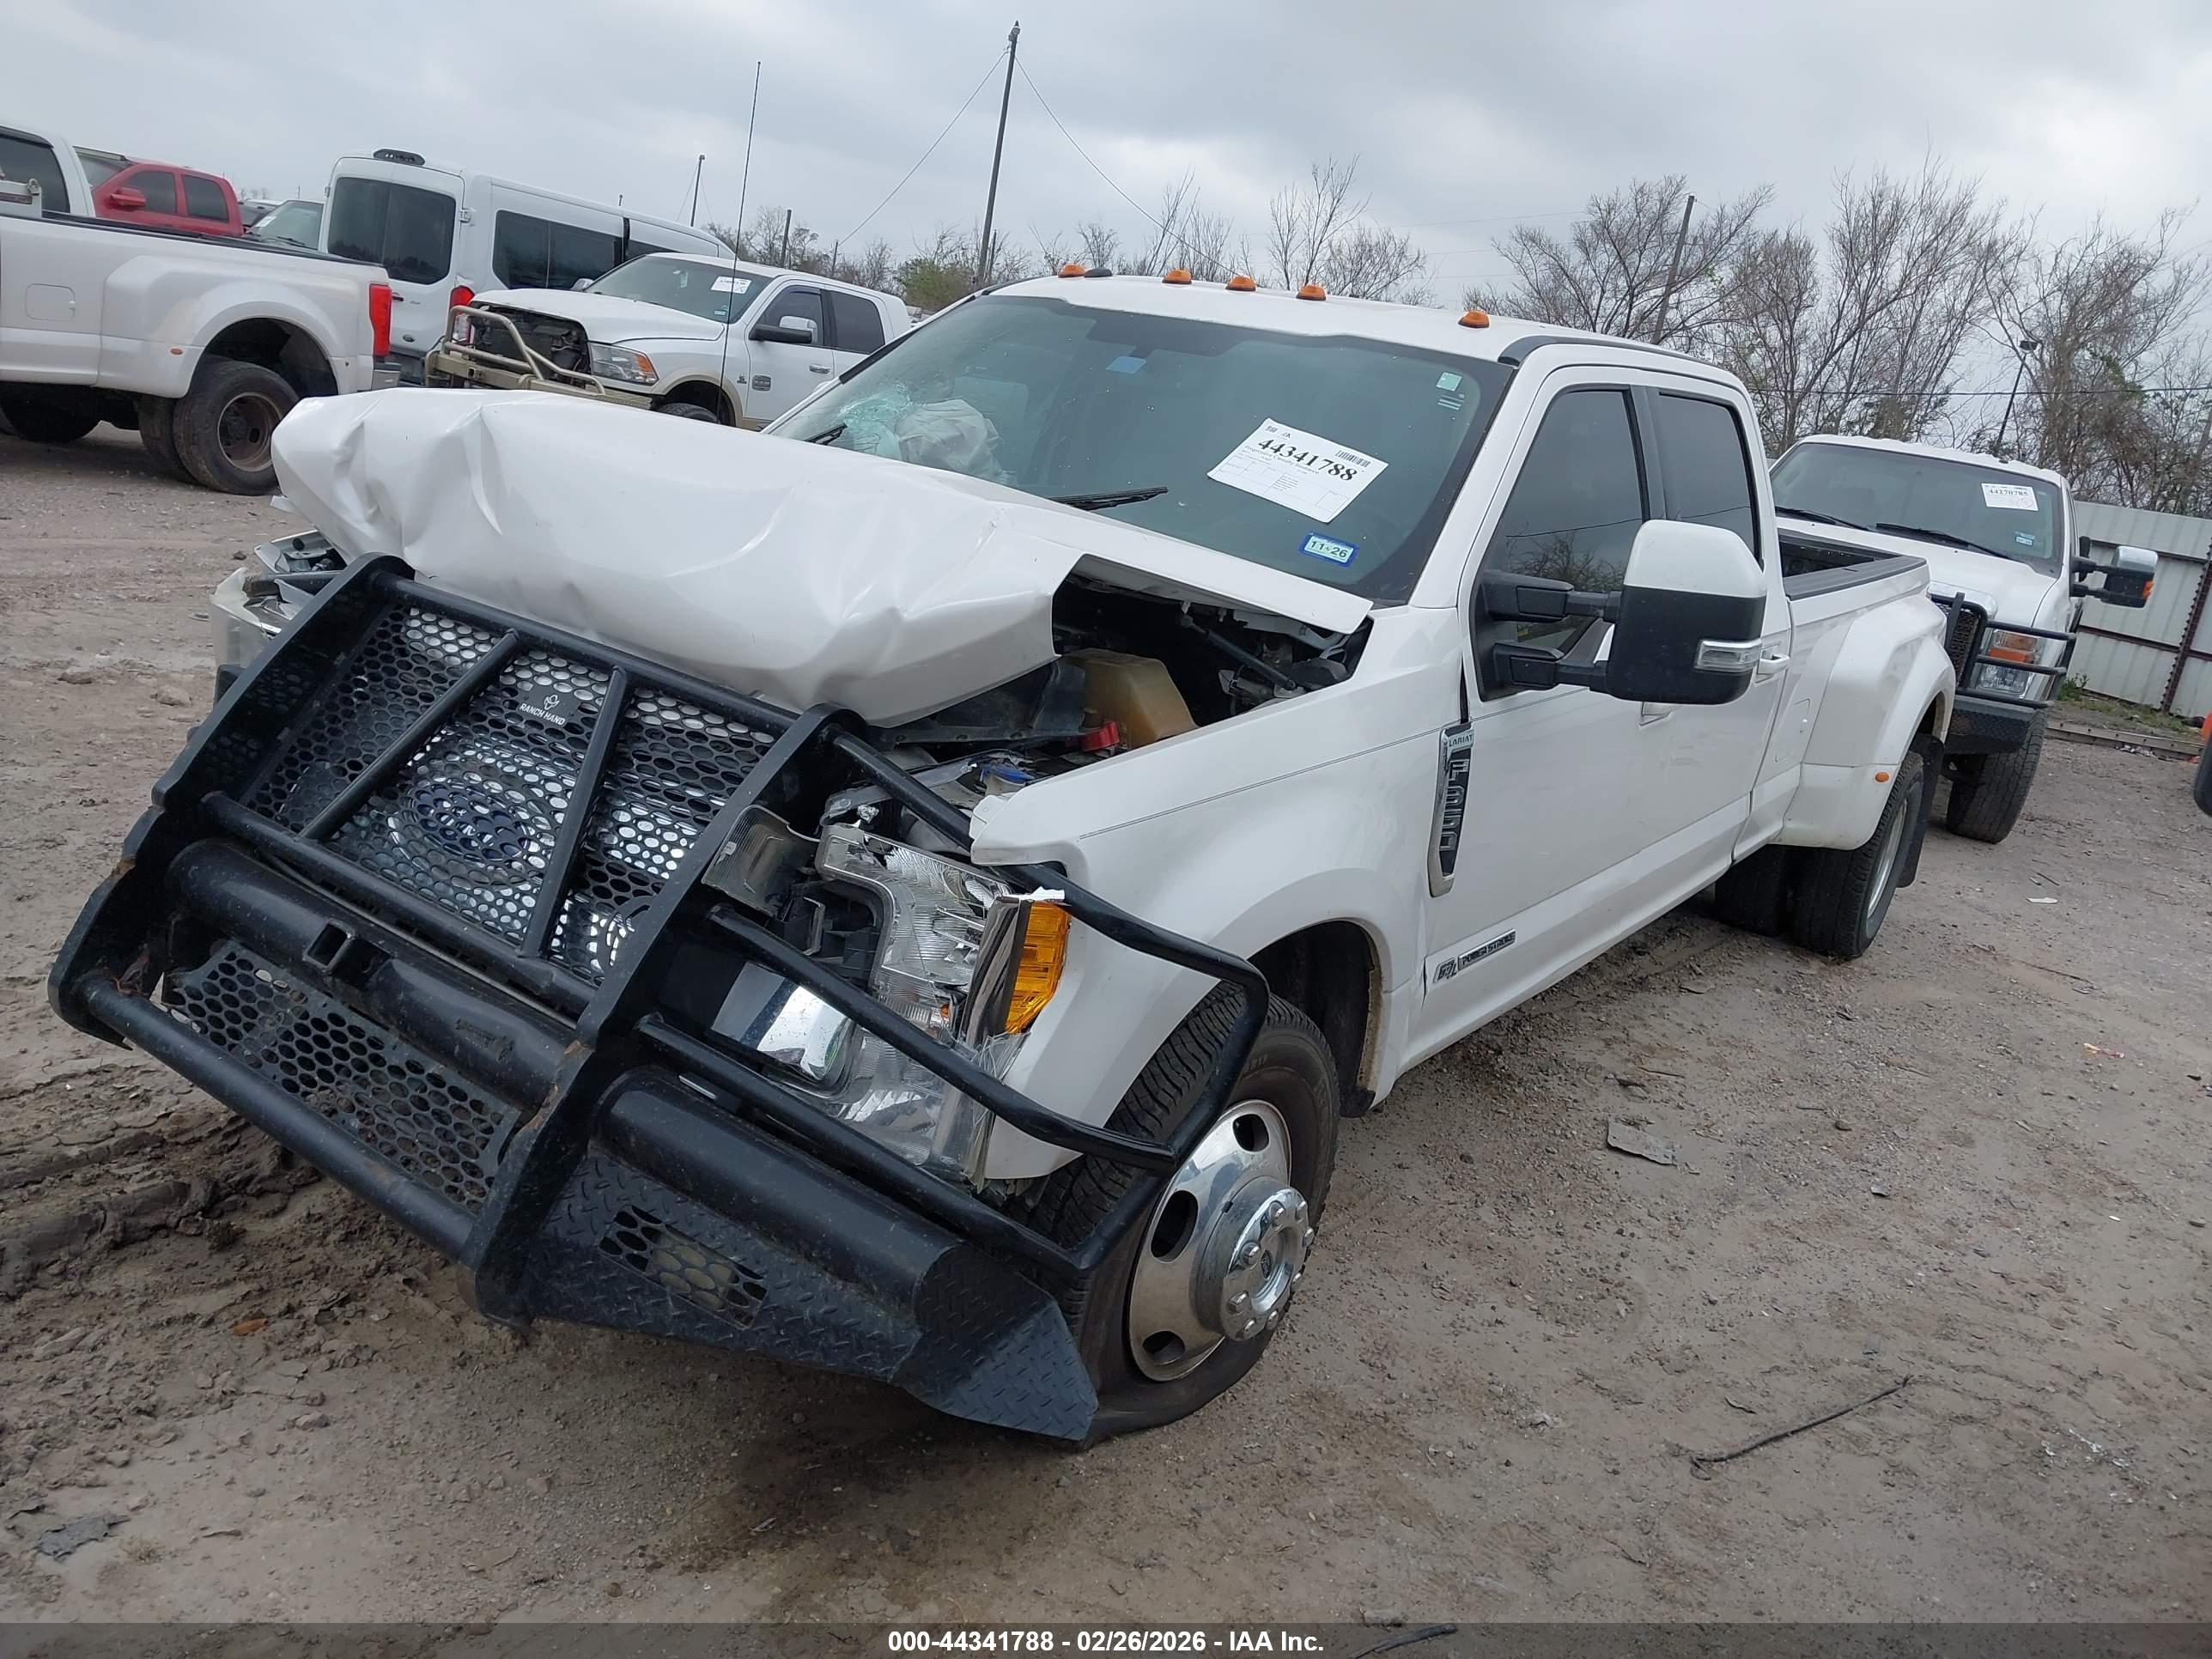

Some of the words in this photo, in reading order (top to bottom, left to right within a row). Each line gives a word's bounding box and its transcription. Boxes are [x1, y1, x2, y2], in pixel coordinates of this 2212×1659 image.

[1258, 439, 1358, 481] 44341788
[519, 703, 545, 718] RANCH
[543, 712, 566, 726] HAND
[1449, 733, 1473, 747] LARIAT
